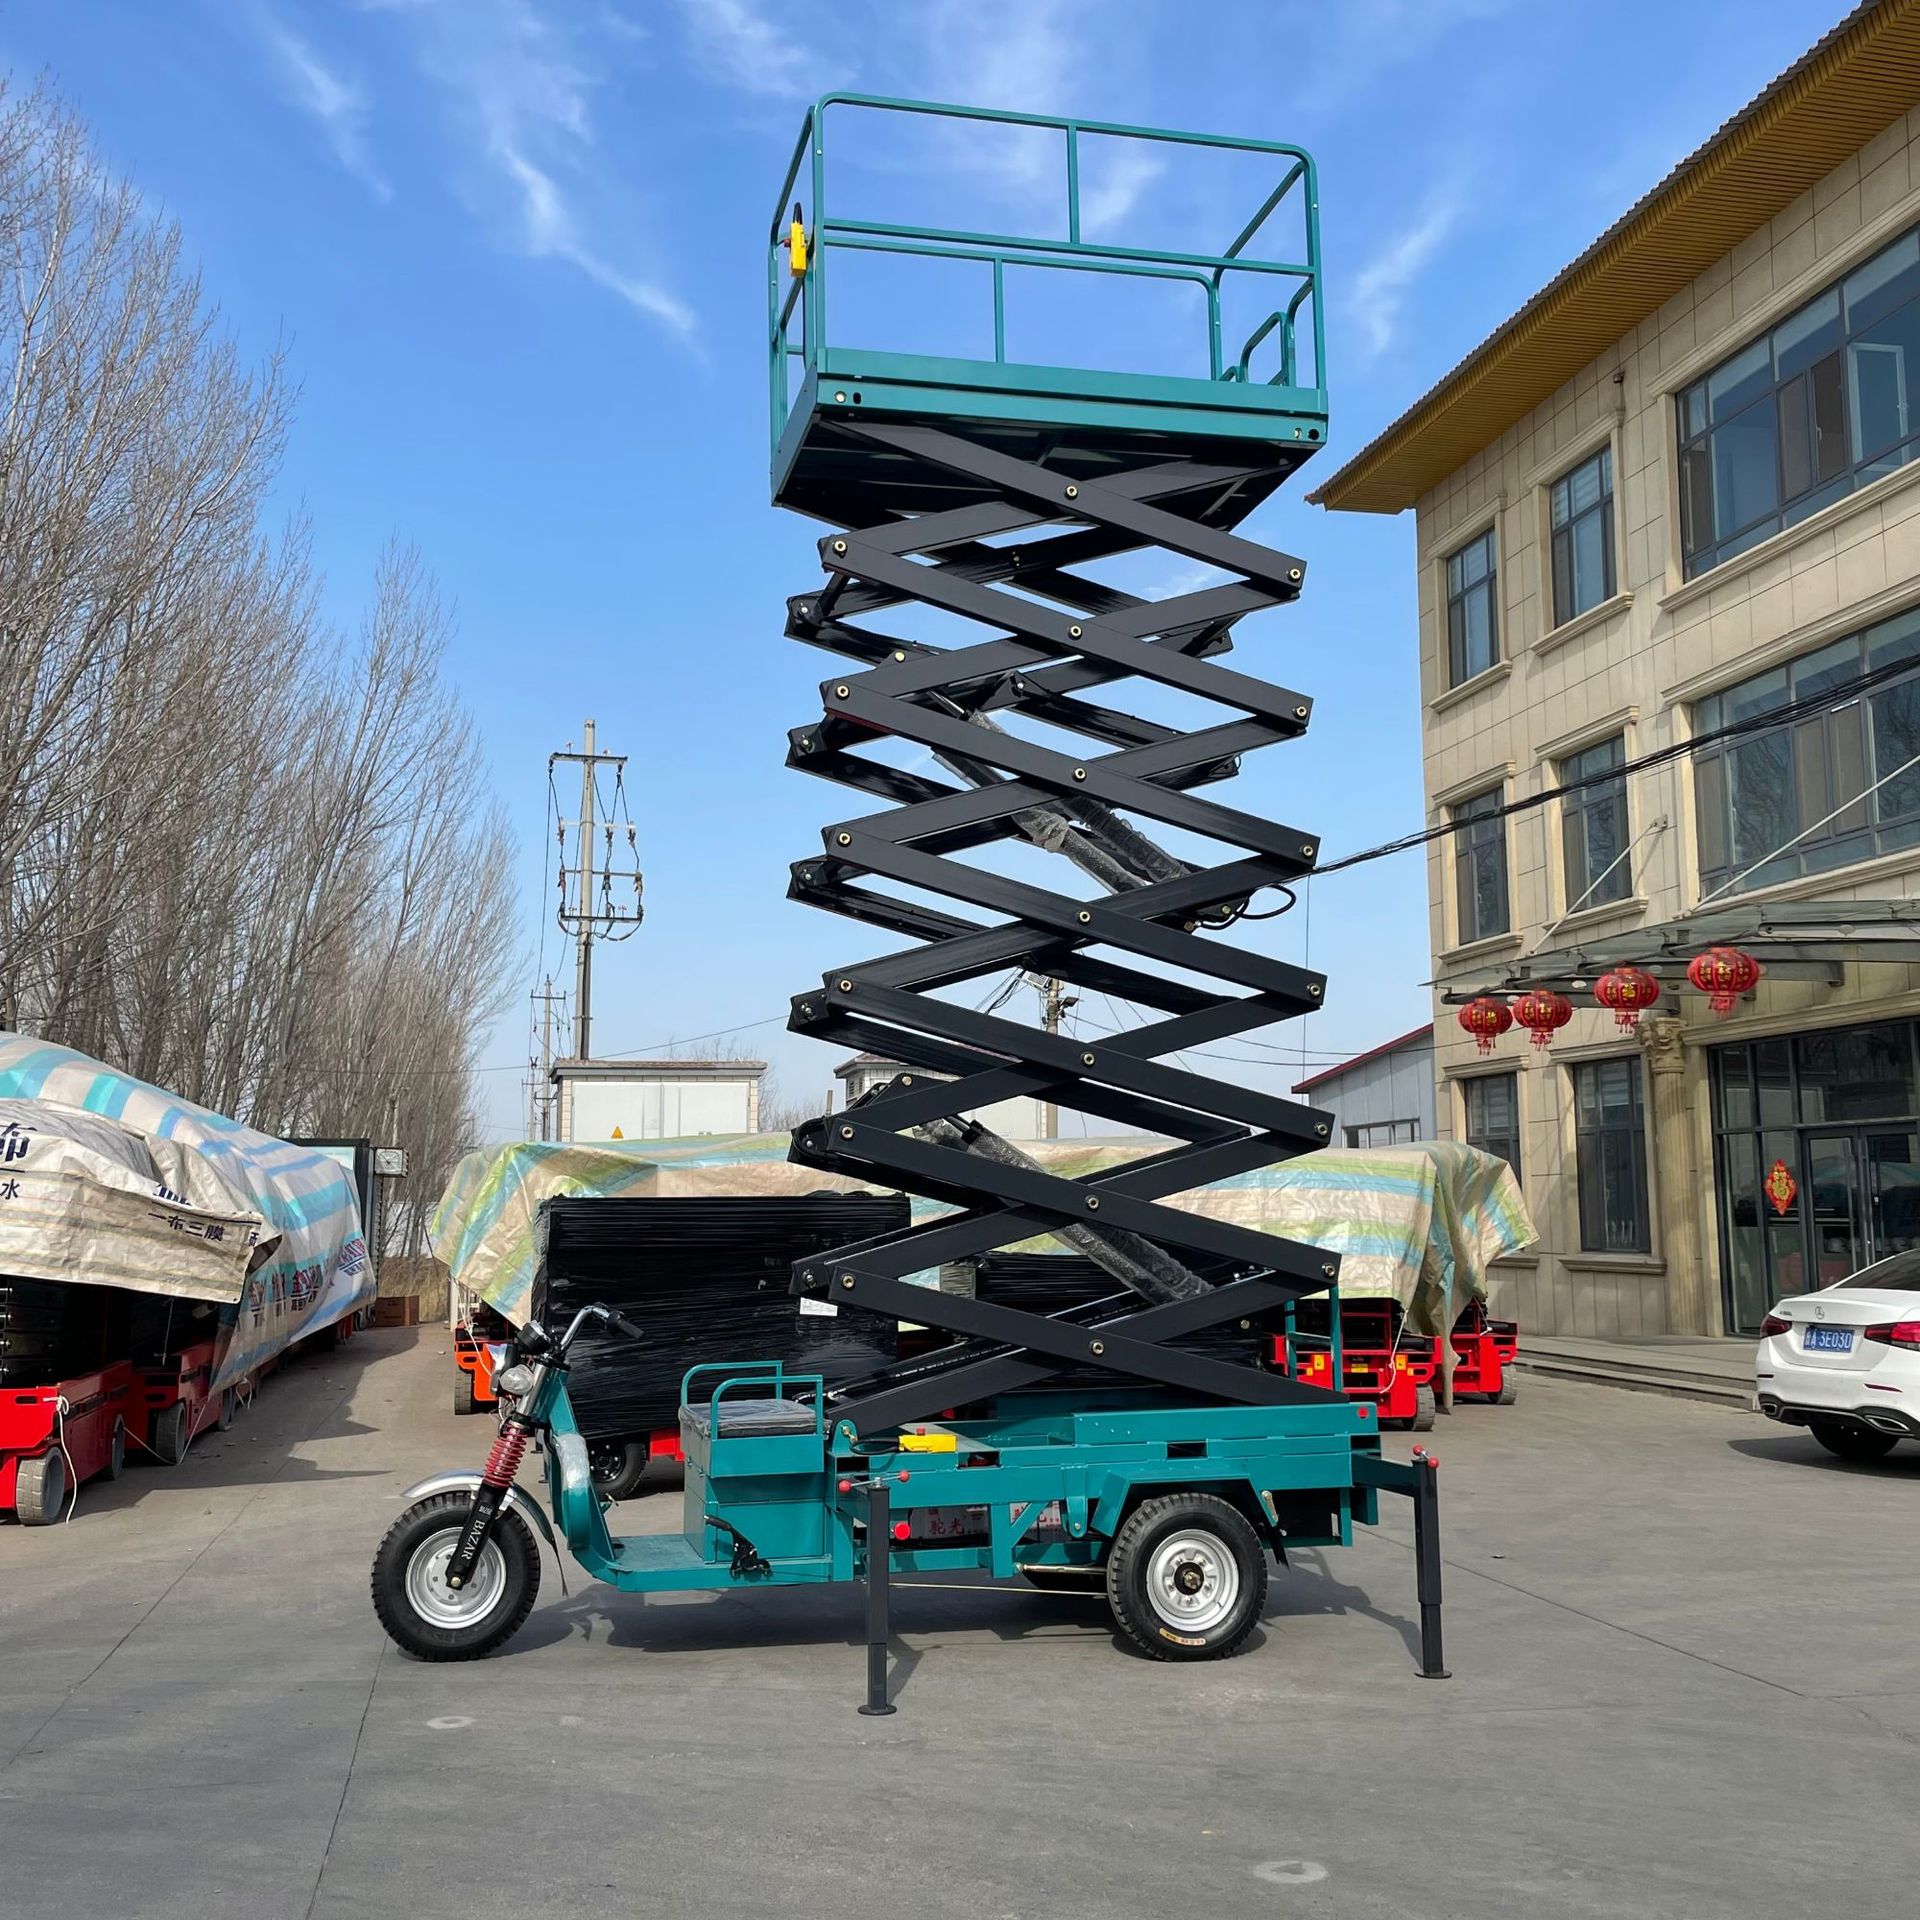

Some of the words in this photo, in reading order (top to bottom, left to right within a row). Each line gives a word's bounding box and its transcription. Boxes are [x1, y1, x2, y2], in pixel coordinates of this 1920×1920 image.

[0, 1178, 20, 1200] 水
[148, 1212, 225, 1241] 一布三膜
[461, 1519, 485, 1559] BAZAR
